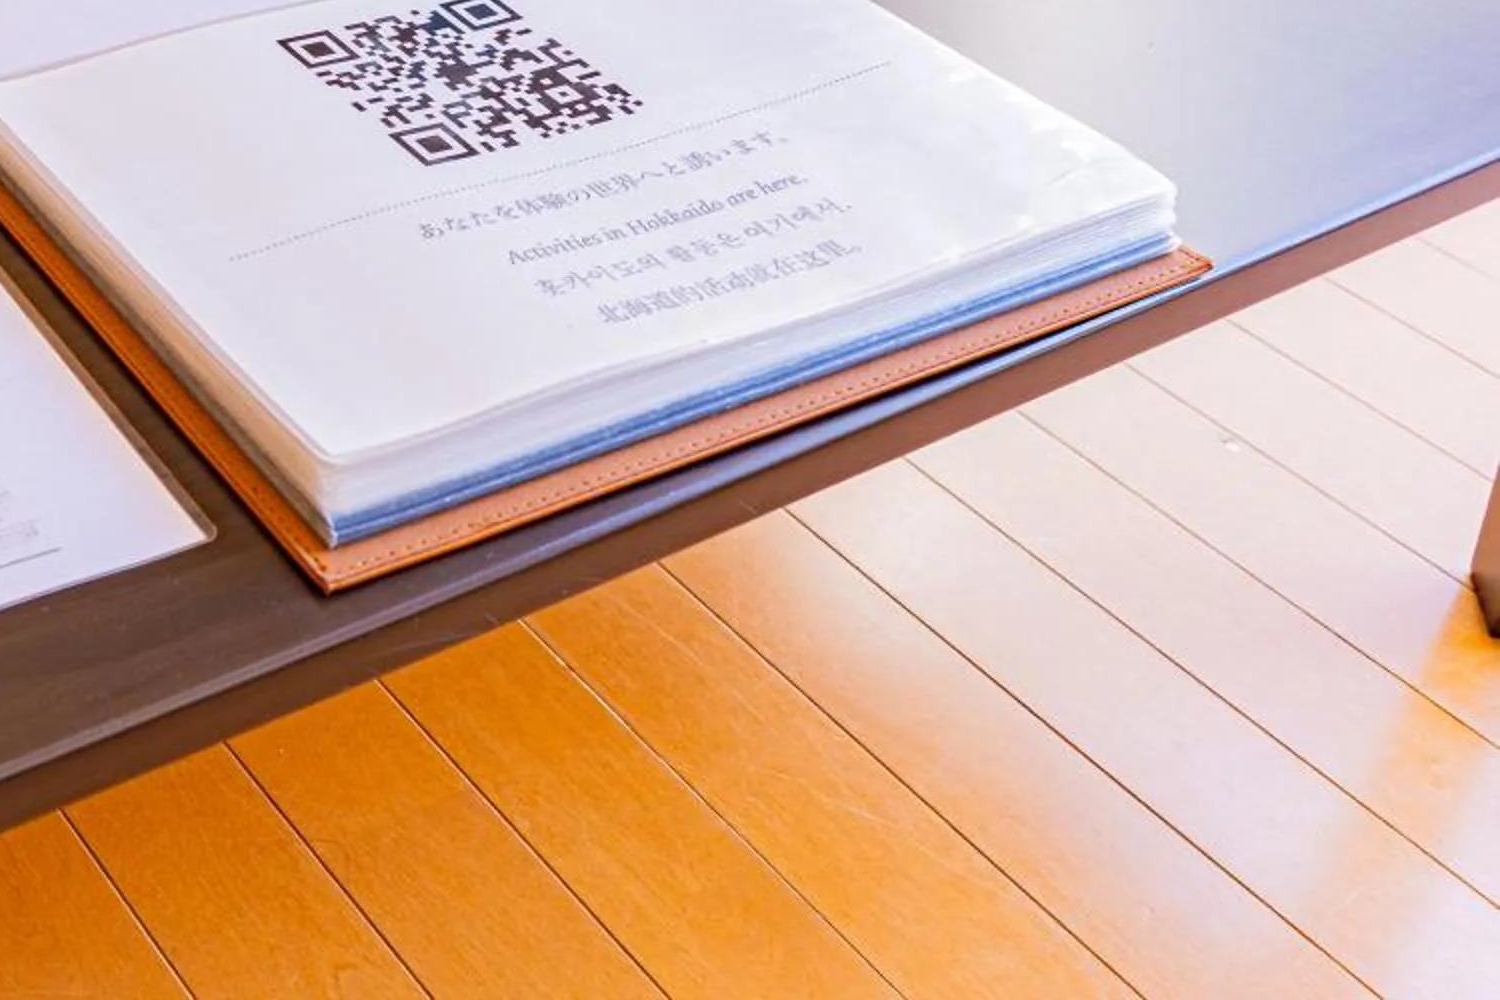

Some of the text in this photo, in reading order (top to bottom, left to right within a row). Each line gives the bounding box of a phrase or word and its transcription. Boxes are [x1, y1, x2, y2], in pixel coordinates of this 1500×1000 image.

[508, 233, 604, 266] Activities
[602, 228, 628, 242] in
[625, 199, 725, 236] Hokkaido
[726, 189, 759, 207] are
